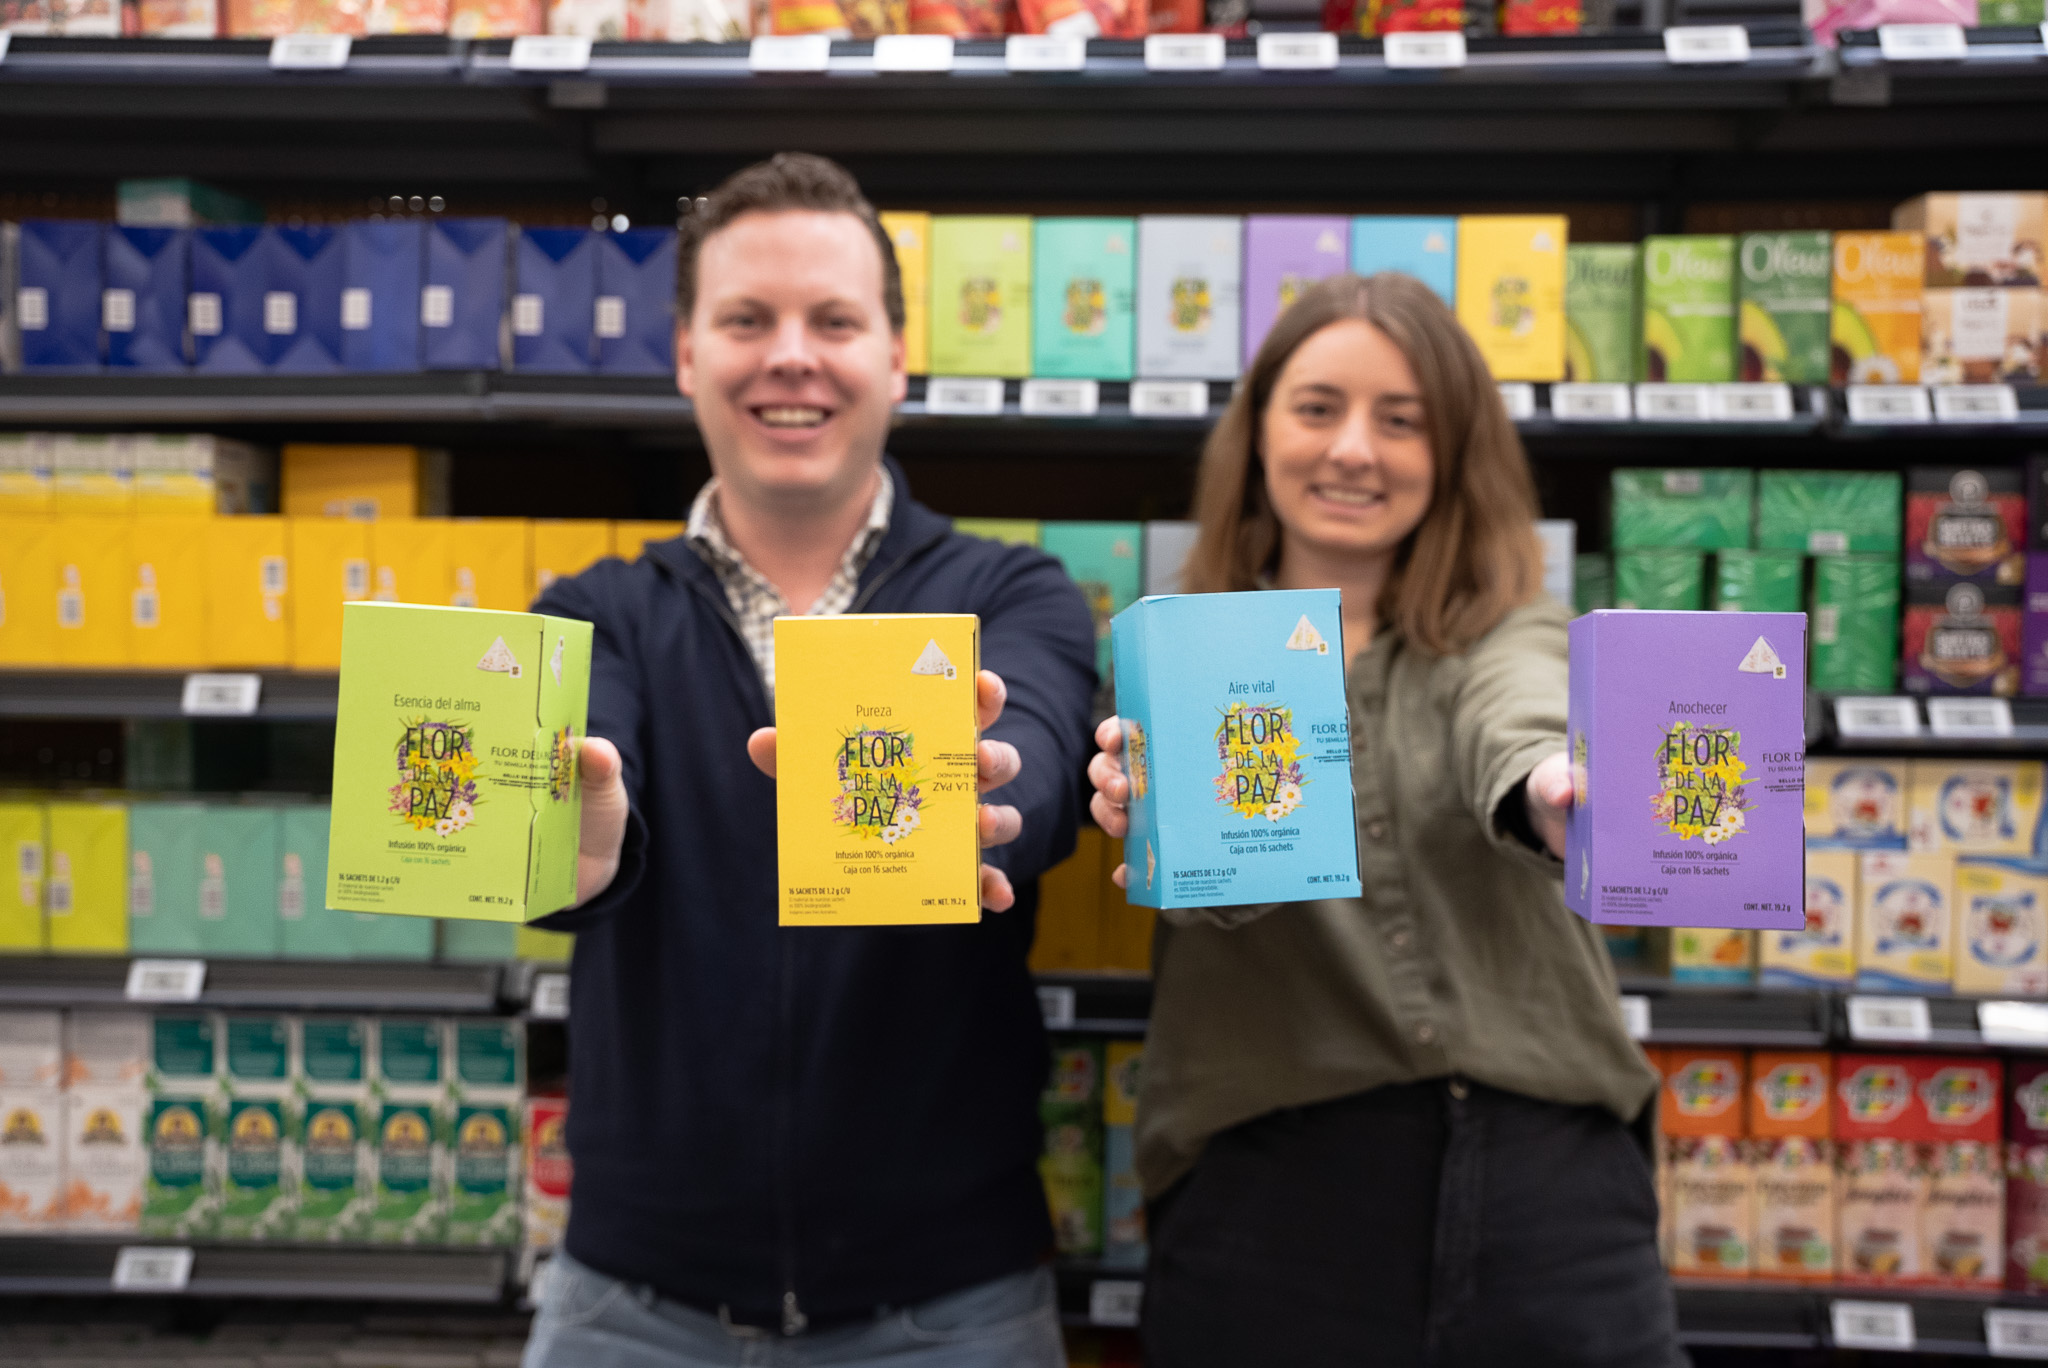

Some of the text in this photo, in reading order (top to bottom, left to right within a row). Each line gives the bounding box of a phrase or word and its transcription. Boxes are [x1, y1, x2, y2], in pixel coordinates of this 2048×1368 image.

[1228, 680, 1275, 694] Aire vital
[394, 694, 480, 711] Esencia del alma
[1668, 701, 1727, 714] Anochecer
[856, 705, 892, 717] Pureza
[1224, 713, 1284, 745] FLOR
[1311, 724, 1337, 734] FLOR
[406, 728, 463, 761] FLOR
[1666, 734, 1729, 766] FLOR
[491, 747, 518, 757] FLOR
[845, 737, 904, 767] FLOR
[1763, 752, 1790, 763] FLOR
[1236, 750, 1278, 769] DE LA
[414, 765, 454, 783] DE LA
[1676, 771, 1720, 790] DE LA
[855, 772, 897, 791] DE LA
[933, 782, 952, 791] PAZ
[1236, 772, 1281, 805] PAZ
[410, 787, 455, 819] PAZ
[854, 796, 898, 826] PAZ
[1674, 795, 1722, 827] PAZ
[1221, 827, 1300, 840] Infusión 100% orgánica
[388, 840, 416, 849] Infusión
[418, 841, 435, 850] 100%
[1230, 842, 1293, 855] Caja con 16 sachets
[836, 850, 914, 860] Infusión 100% orgánica
[1653, 850, 1737, 861] Infusión 100% orgánica
[843, 865, 858, 875] Caja
[873, 865, 880, 873] 16
[882, 865, 907, 873] sachets
[1180, 870, 1203, 878] SACHETS
[1204, 869, 1211, 877] DE
[1661, 865, 1676, 875] Caja
[1693, 866, 1701, 874] 16
[1702, 866, 1729, 876] sachets
[789, 887, 795, 895] 16
[796, 887, 818, 895] SACHETS
[1609, 886, 1633, 894] SACHETS
[1634, 886, 1640, 894] DE
[1657, 887, 1668, 895] C/U
